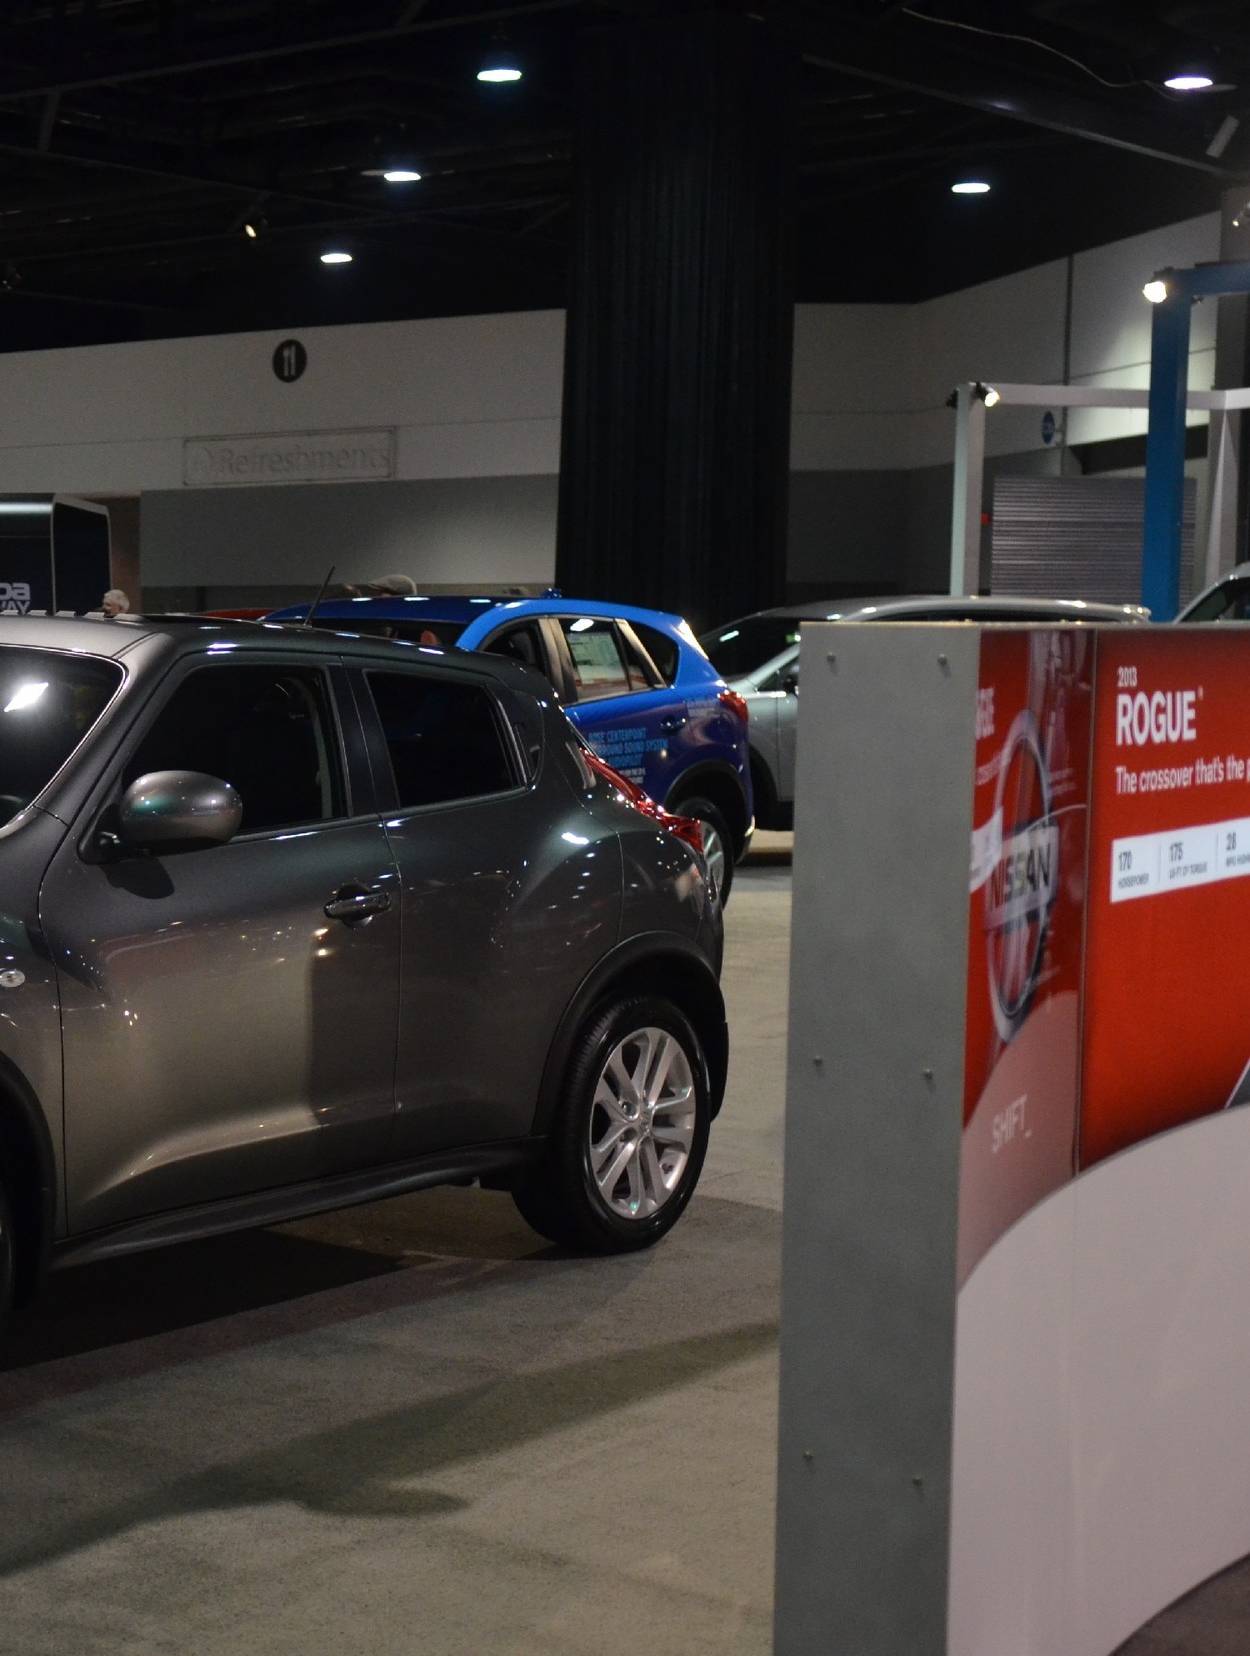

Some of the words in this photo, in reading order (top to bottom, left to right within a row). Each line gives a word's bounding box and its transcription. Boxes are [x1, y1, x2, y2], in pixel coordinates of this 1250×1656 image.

[1117, 666, 1138, 688] 2013
[1116, 765, 1137, 794] The
[1139, 766, 1193, 792] crossover
[1195, 757, 1225, 785] that's
[1226, 754, 1245, 781] the
[1170, 842, 1183, 862] 175
[1226, 832, 1237, 851] 28
[1118, 850, 1132, 871] 170
